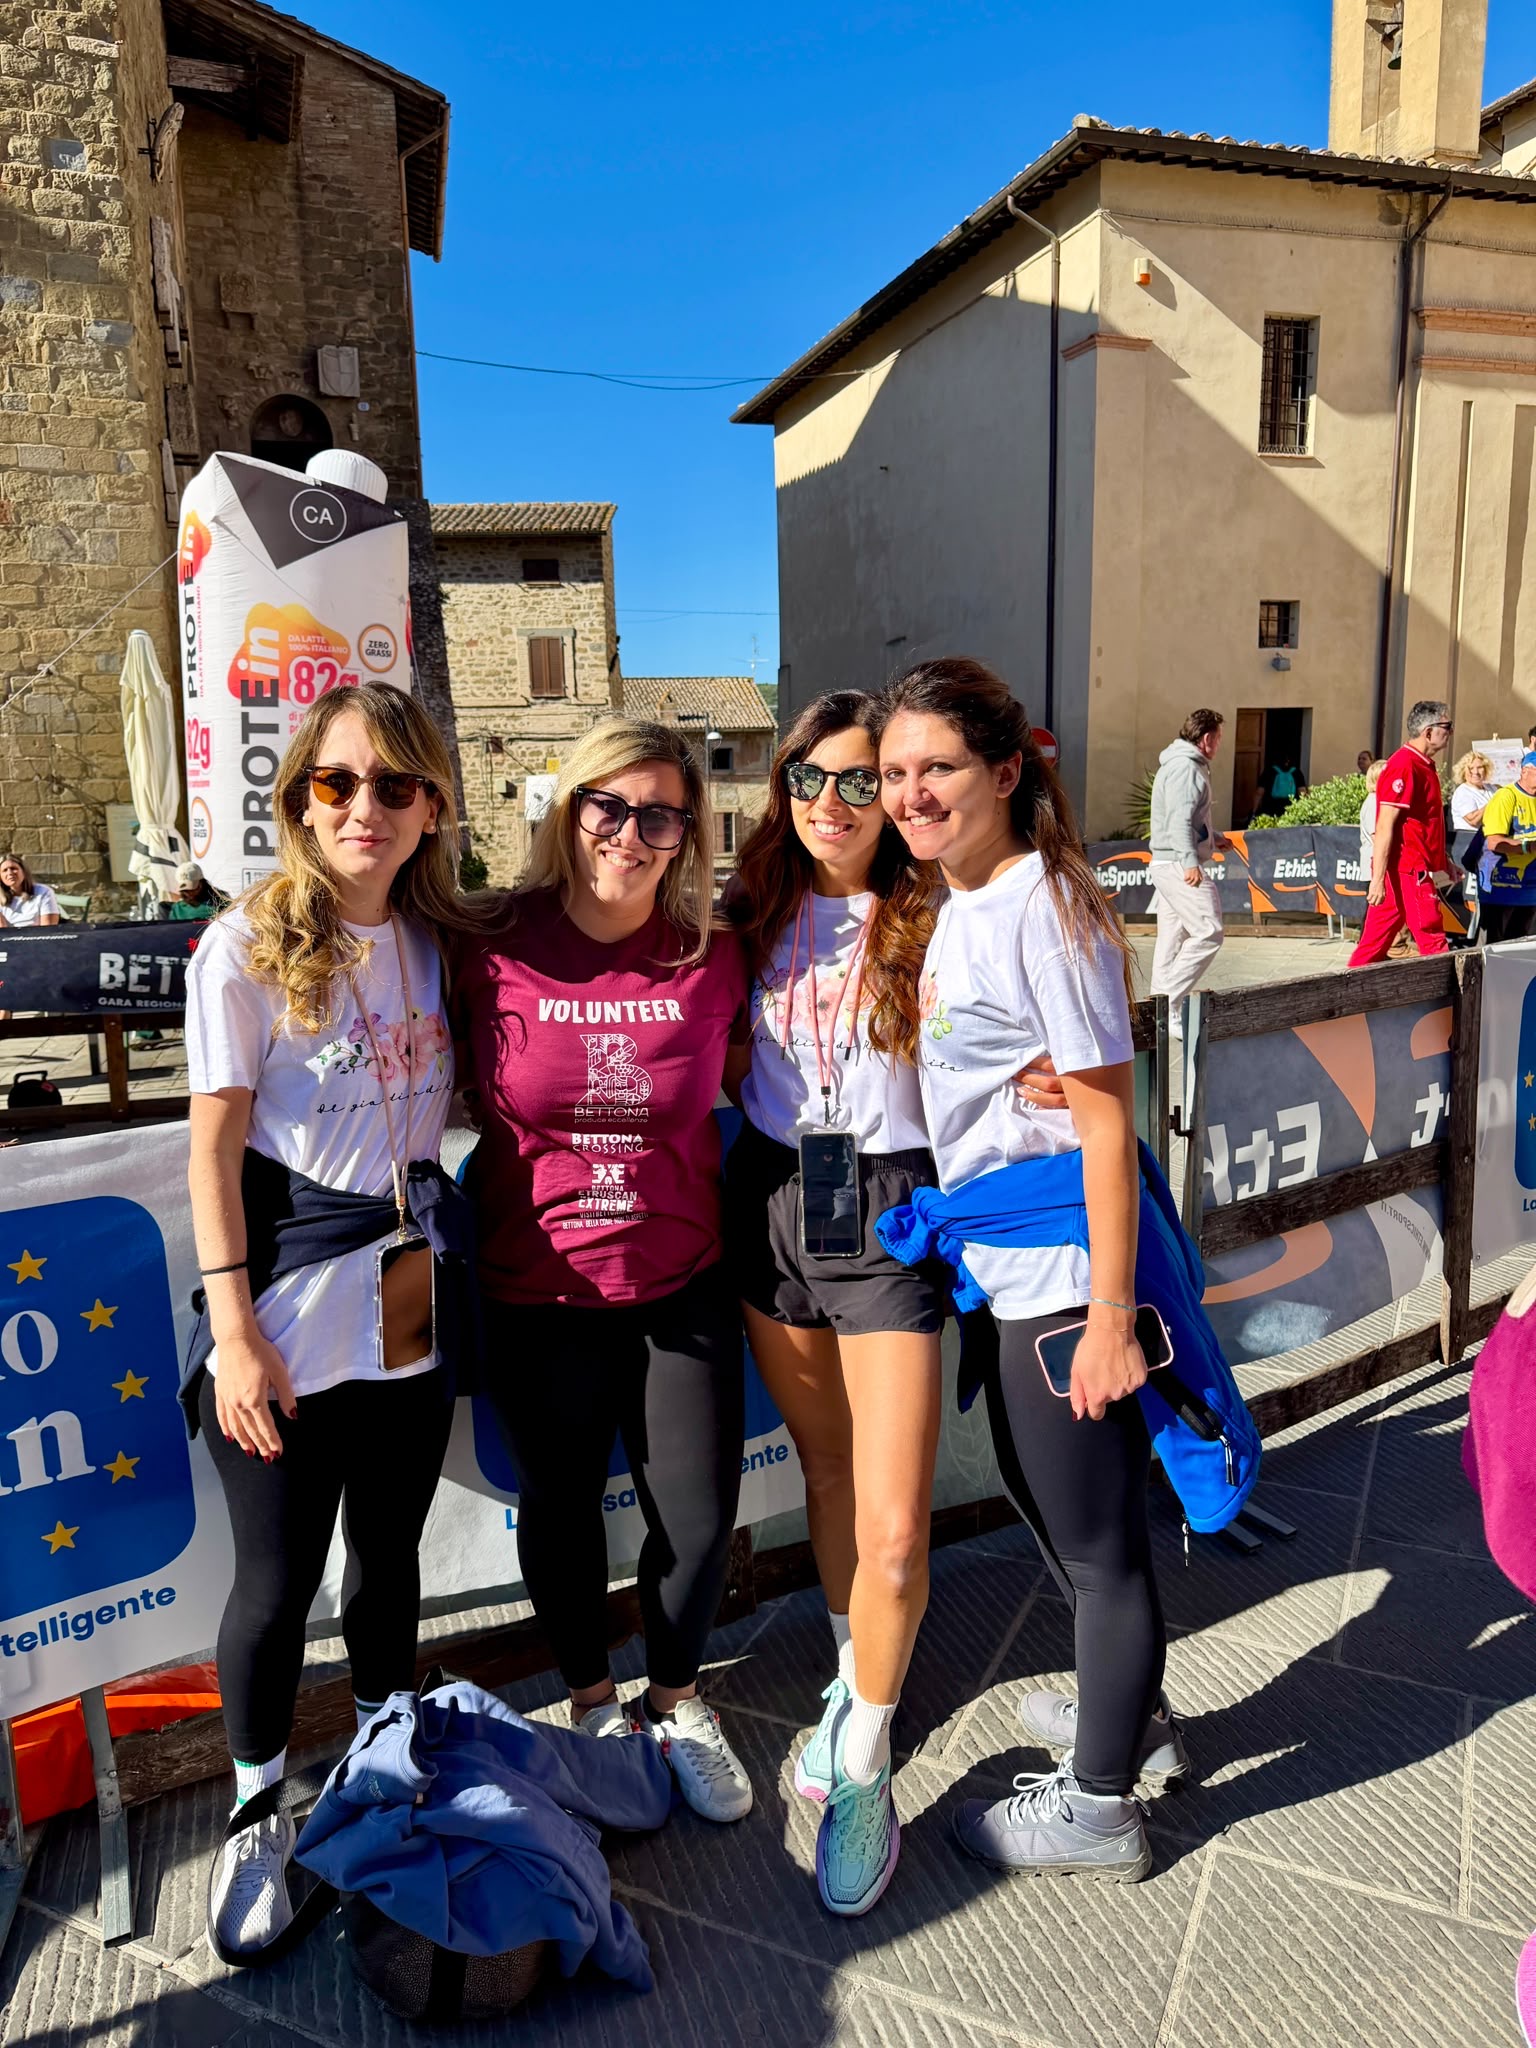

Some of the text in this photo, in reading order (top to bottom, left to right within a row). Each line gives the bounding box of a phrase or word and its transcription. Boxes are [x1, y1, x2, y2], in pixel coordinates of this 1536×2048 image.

[303, 505, 334, 526] CA
[288, 635, 302, 643] DA
[311, 645, 349, 654] ITALIANO
[368, 640, 389, 650] ZERO
[364, 648, 392, 658] GRASSI
[1095, 865, 1152, 892] icSport
[99, 952, 190, 995] BET
[98, 997, 132, 1008] GARA
[538, 998, 685, 1024] VOLUNTEER
[574, 1107, 649, 1117] BETTONA
[571, 1133, 644, 1145] BETTONA
[572, 1143, 644, 1155] CROSSING
[578, 1190, 638, 1200] ETRUSCAN
[578, 1199, 634, 1212] EXTREME
[586, 1218, 600, 1228] BELLA
